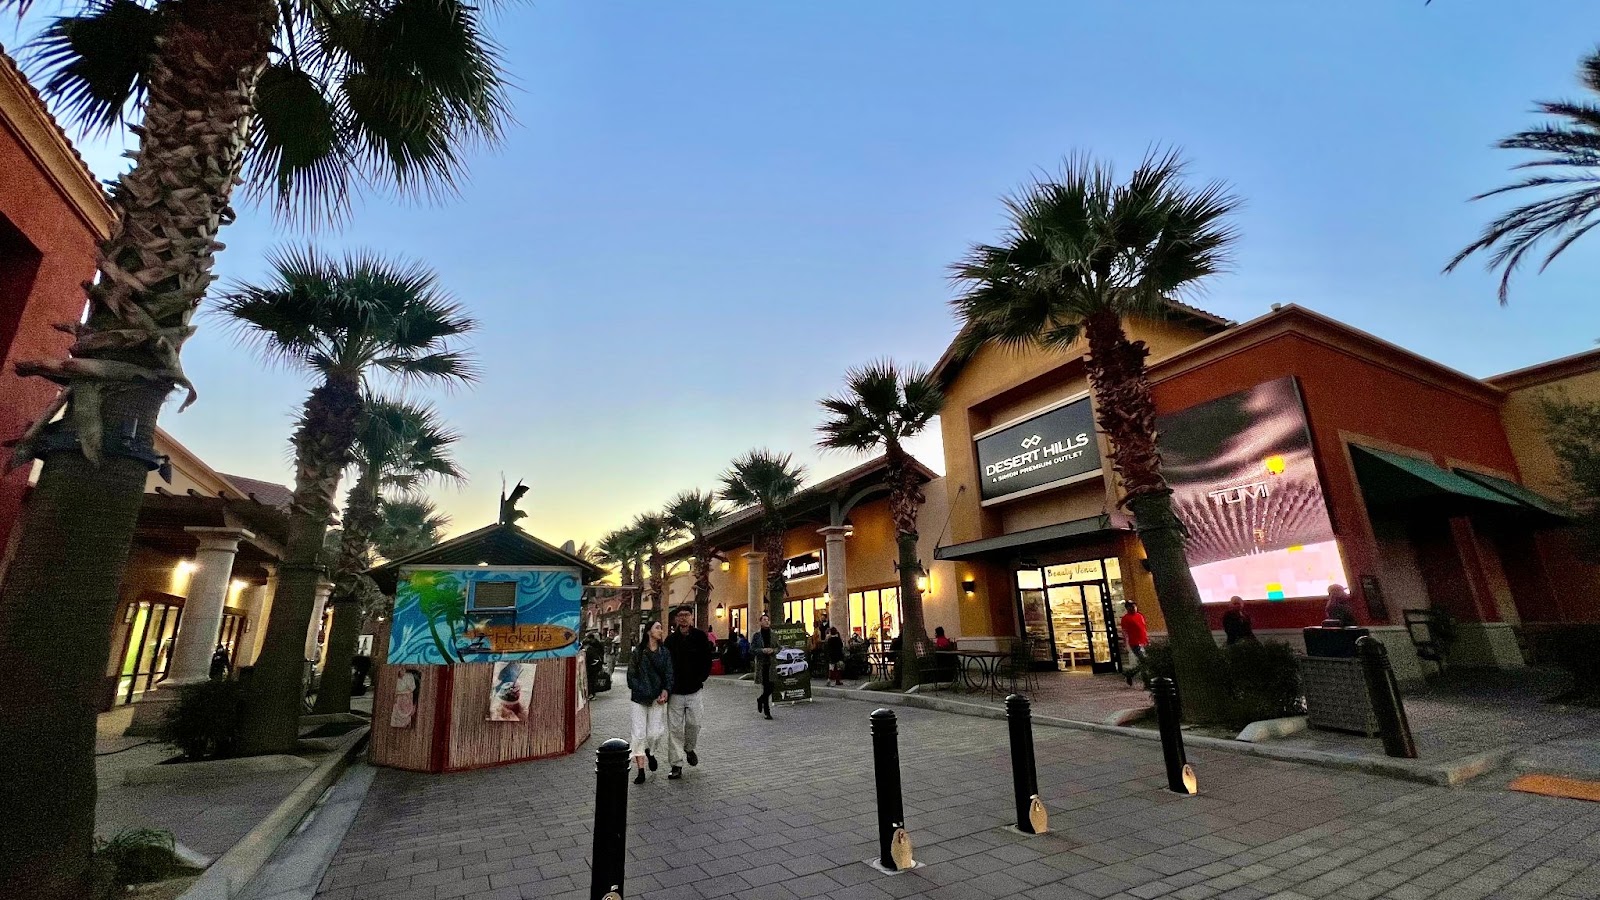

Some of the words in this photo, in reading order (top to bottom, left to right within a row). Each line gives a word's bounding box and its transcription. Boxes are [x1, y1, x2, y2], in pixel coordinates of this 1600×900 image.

[986, 449, 1040, 476] DESERT
[1043, 433, 1089, 457] HILLS
[1020, 460, 1052, 474] PREMIUM
[1054, 450, 1083, 464] OUTLET
[1209, 482, 1269, 505] TUMI
[1047, 567, 1073, 580] Beauty
